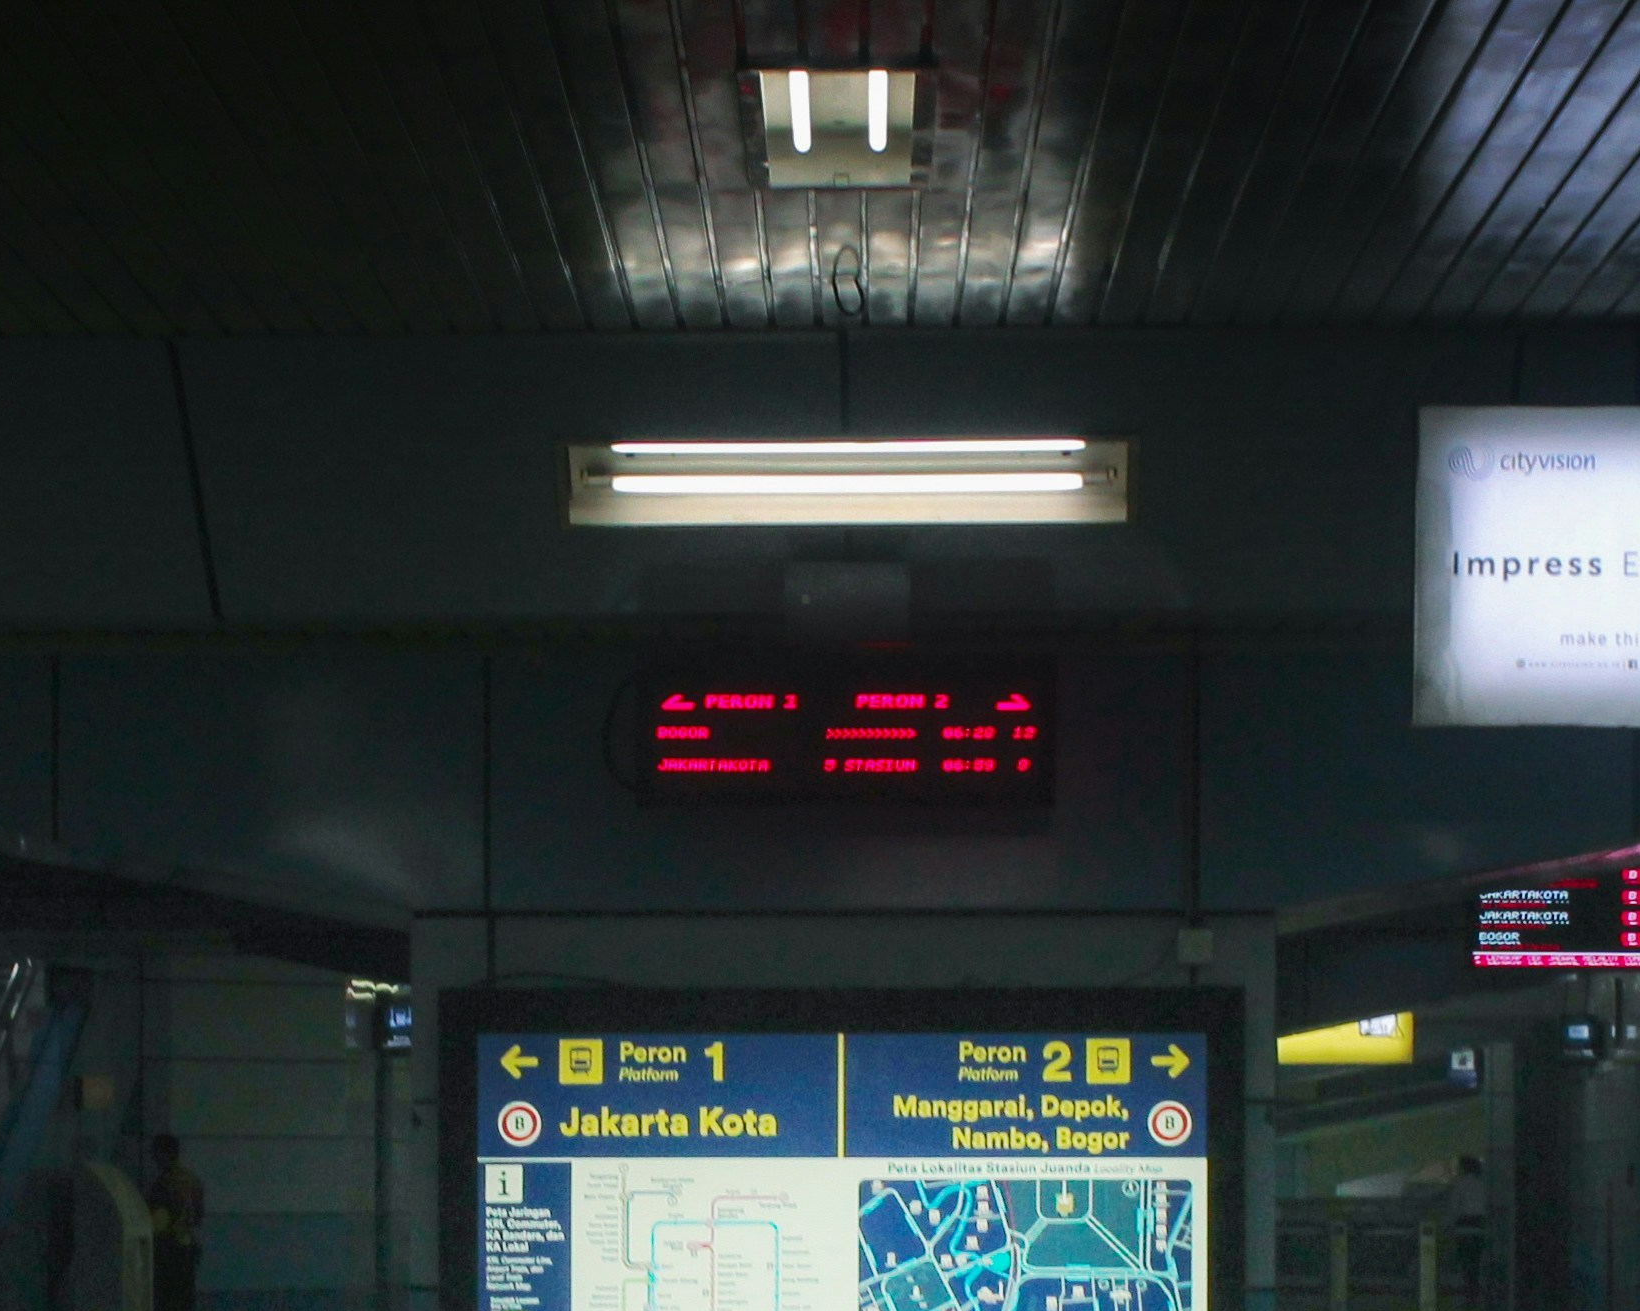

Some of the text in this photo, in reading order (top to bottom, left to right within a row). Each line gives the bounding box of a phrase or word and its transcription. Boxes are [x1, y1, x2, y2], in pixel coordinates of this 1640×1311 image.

[1500, 449, 1596, 475] cityvision
[1452, 551, 1603, 582] Impress
[1560, 632, 1607, 647] make
[704, 694, 775, 710] PERON
[855, 694, 950, 710] PERON 2
[656, 725, 711, 740] BOGOR
[657, 758, 771, 773] JAKARTAKOTA
[844, 758, 919, 773] STASIUN
[1479, 911, 1570, 925] JAKARTAKOTA
[1478, 931, 1522, 945] BOGOR
[618, 1041, 725, 1082] Peron 1
[959, 1041, 1072, 1082] Peron 2
[618, 1067, 679, 1083] Platform
[958, 1066, 1019, 1082] Platform
[892, 1094, 1130, 1122] Manggarai, Depok,
[514, 1116, 525, 1130] B
[559, 1106, 778, 1137] Jakarta Kota
[1164, 1115, 1175, 1130] B
[952, 1126, 1131, 1155] Nambo, Bogor
[888, 1162, 918, 1175] Peta
[922, 1162, 983, 1175] Lokalitas
[986, 1162, 1037, 1175] Stasiun
[1041, 1162, 1092, 1175] Juanda
[486, 1241, 502, 1253] KA
